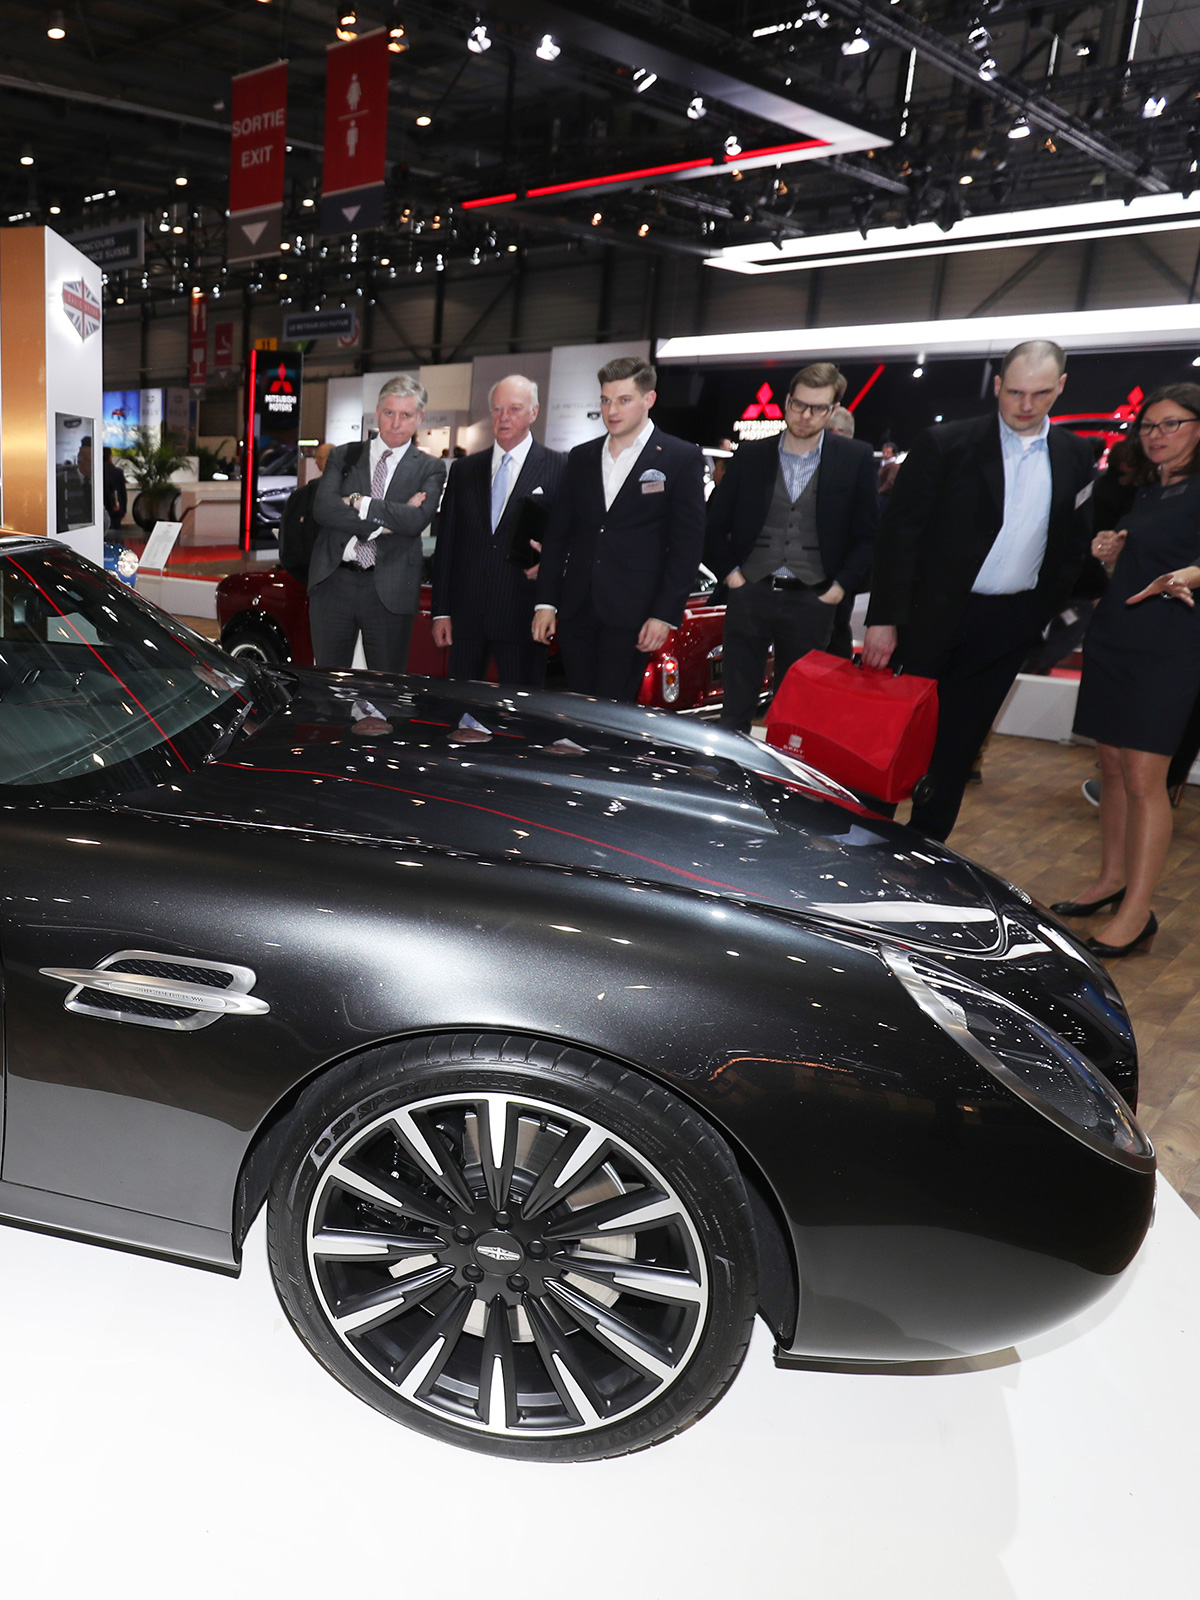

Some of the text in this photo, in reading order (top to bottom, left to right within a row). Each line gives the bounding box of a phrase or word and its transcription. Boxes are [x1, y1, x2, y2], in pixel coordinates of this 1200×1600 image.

[232, 108, 285, 138] SORTIE
[241, 145, 273, 168] EXIT
[264, 394, 297, 404] MITSUBISHI
[268, 402, 293, 412] MOTORS
[356, 1080, 430, 1120] SPORT
